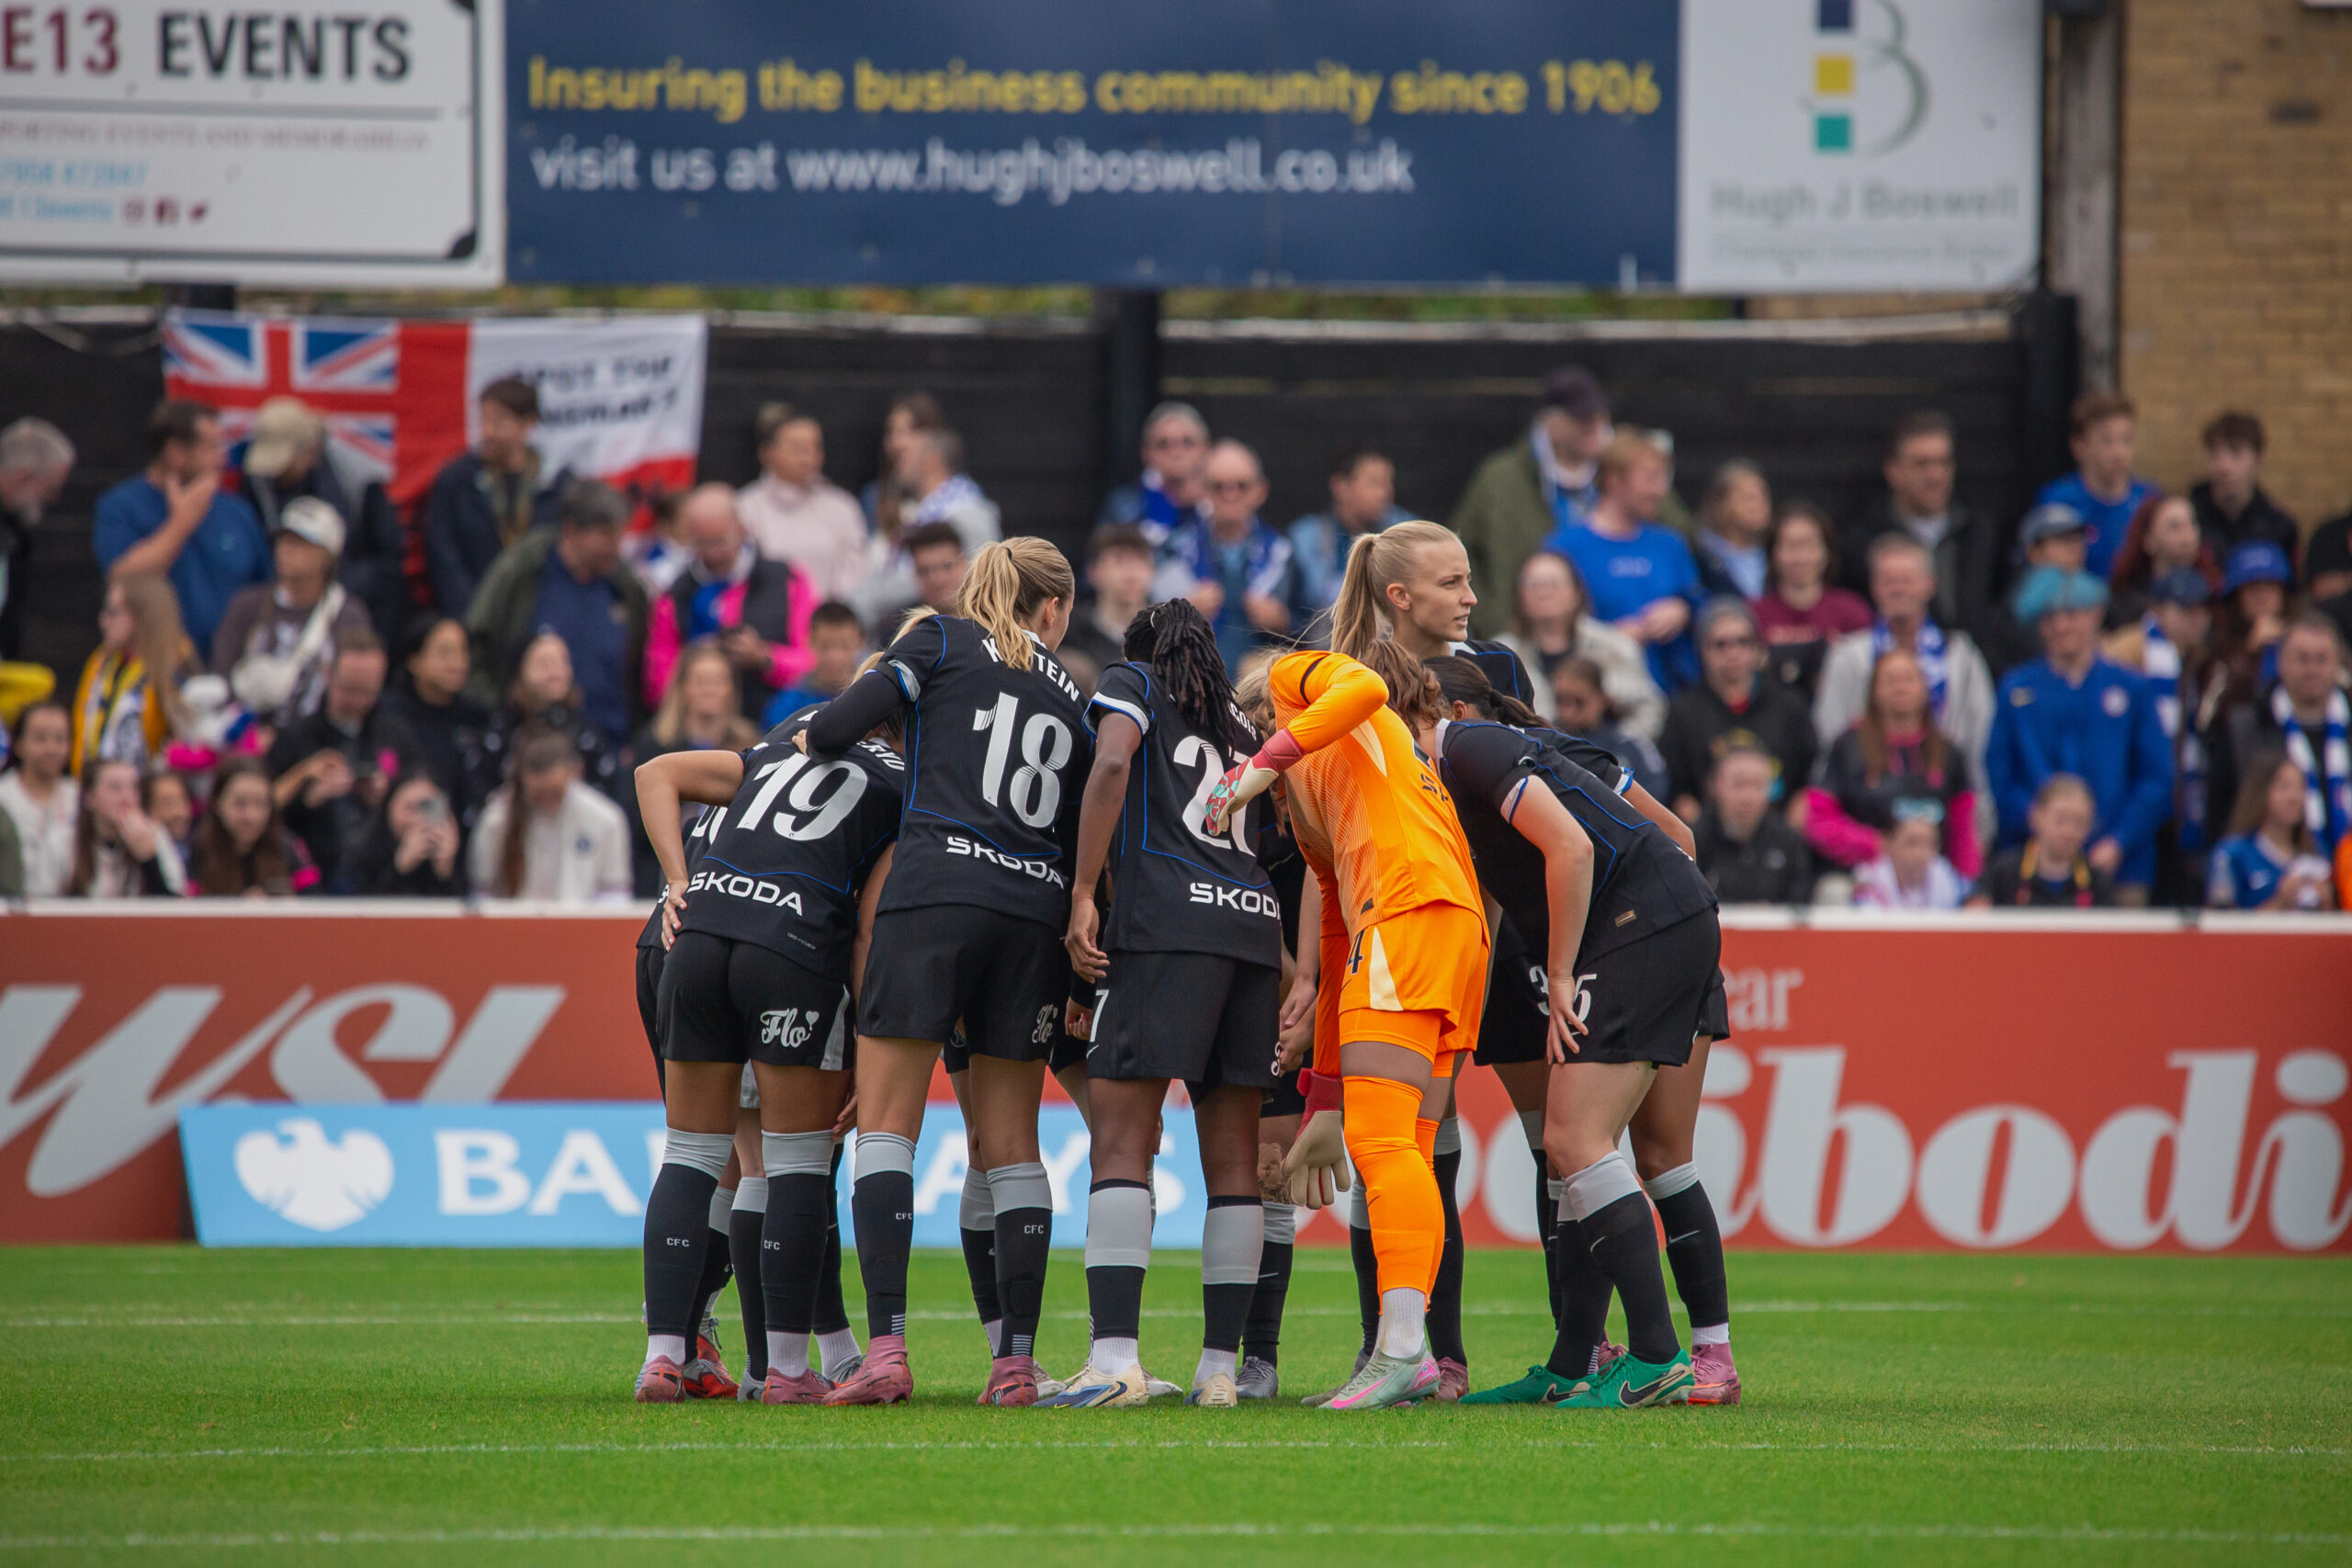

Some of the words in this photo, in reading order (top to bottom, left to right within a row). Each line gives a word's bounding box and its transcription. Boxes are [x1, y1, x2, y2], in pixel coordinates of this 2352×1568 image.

[1, 6, 119, 75] E13
[158, 11, 412, 81] EVENTS
[530, 57, 747, 122] Insuring
[759, 60, 843, 112] the
[854, 61, 1086, 113] business
[1096, 62, 1382, 124] community
[1391, 63, 1528, 113] since
[1541, 61, 1661, 114] 1906
[530, 140, 639, 190] visit
[651, 148, 716, 191] us
[725, 143, 778, 191] at
[786, 138, 1415, 205] www.hughjboswell.co.uk
[982, 637, 1080, 703] KTEIN
[973, 691, 1073, 828] 18
[736, 750, 869, 841] 19
[1190, 882, 1281, 920] SKOD
[666, 1237, 690, 1247] CFC
[763, 1239, 780, 1250] CFC
[895, 1212, 912, 1221] CFC
[1023, 1224, 1045, 1235] CFC
